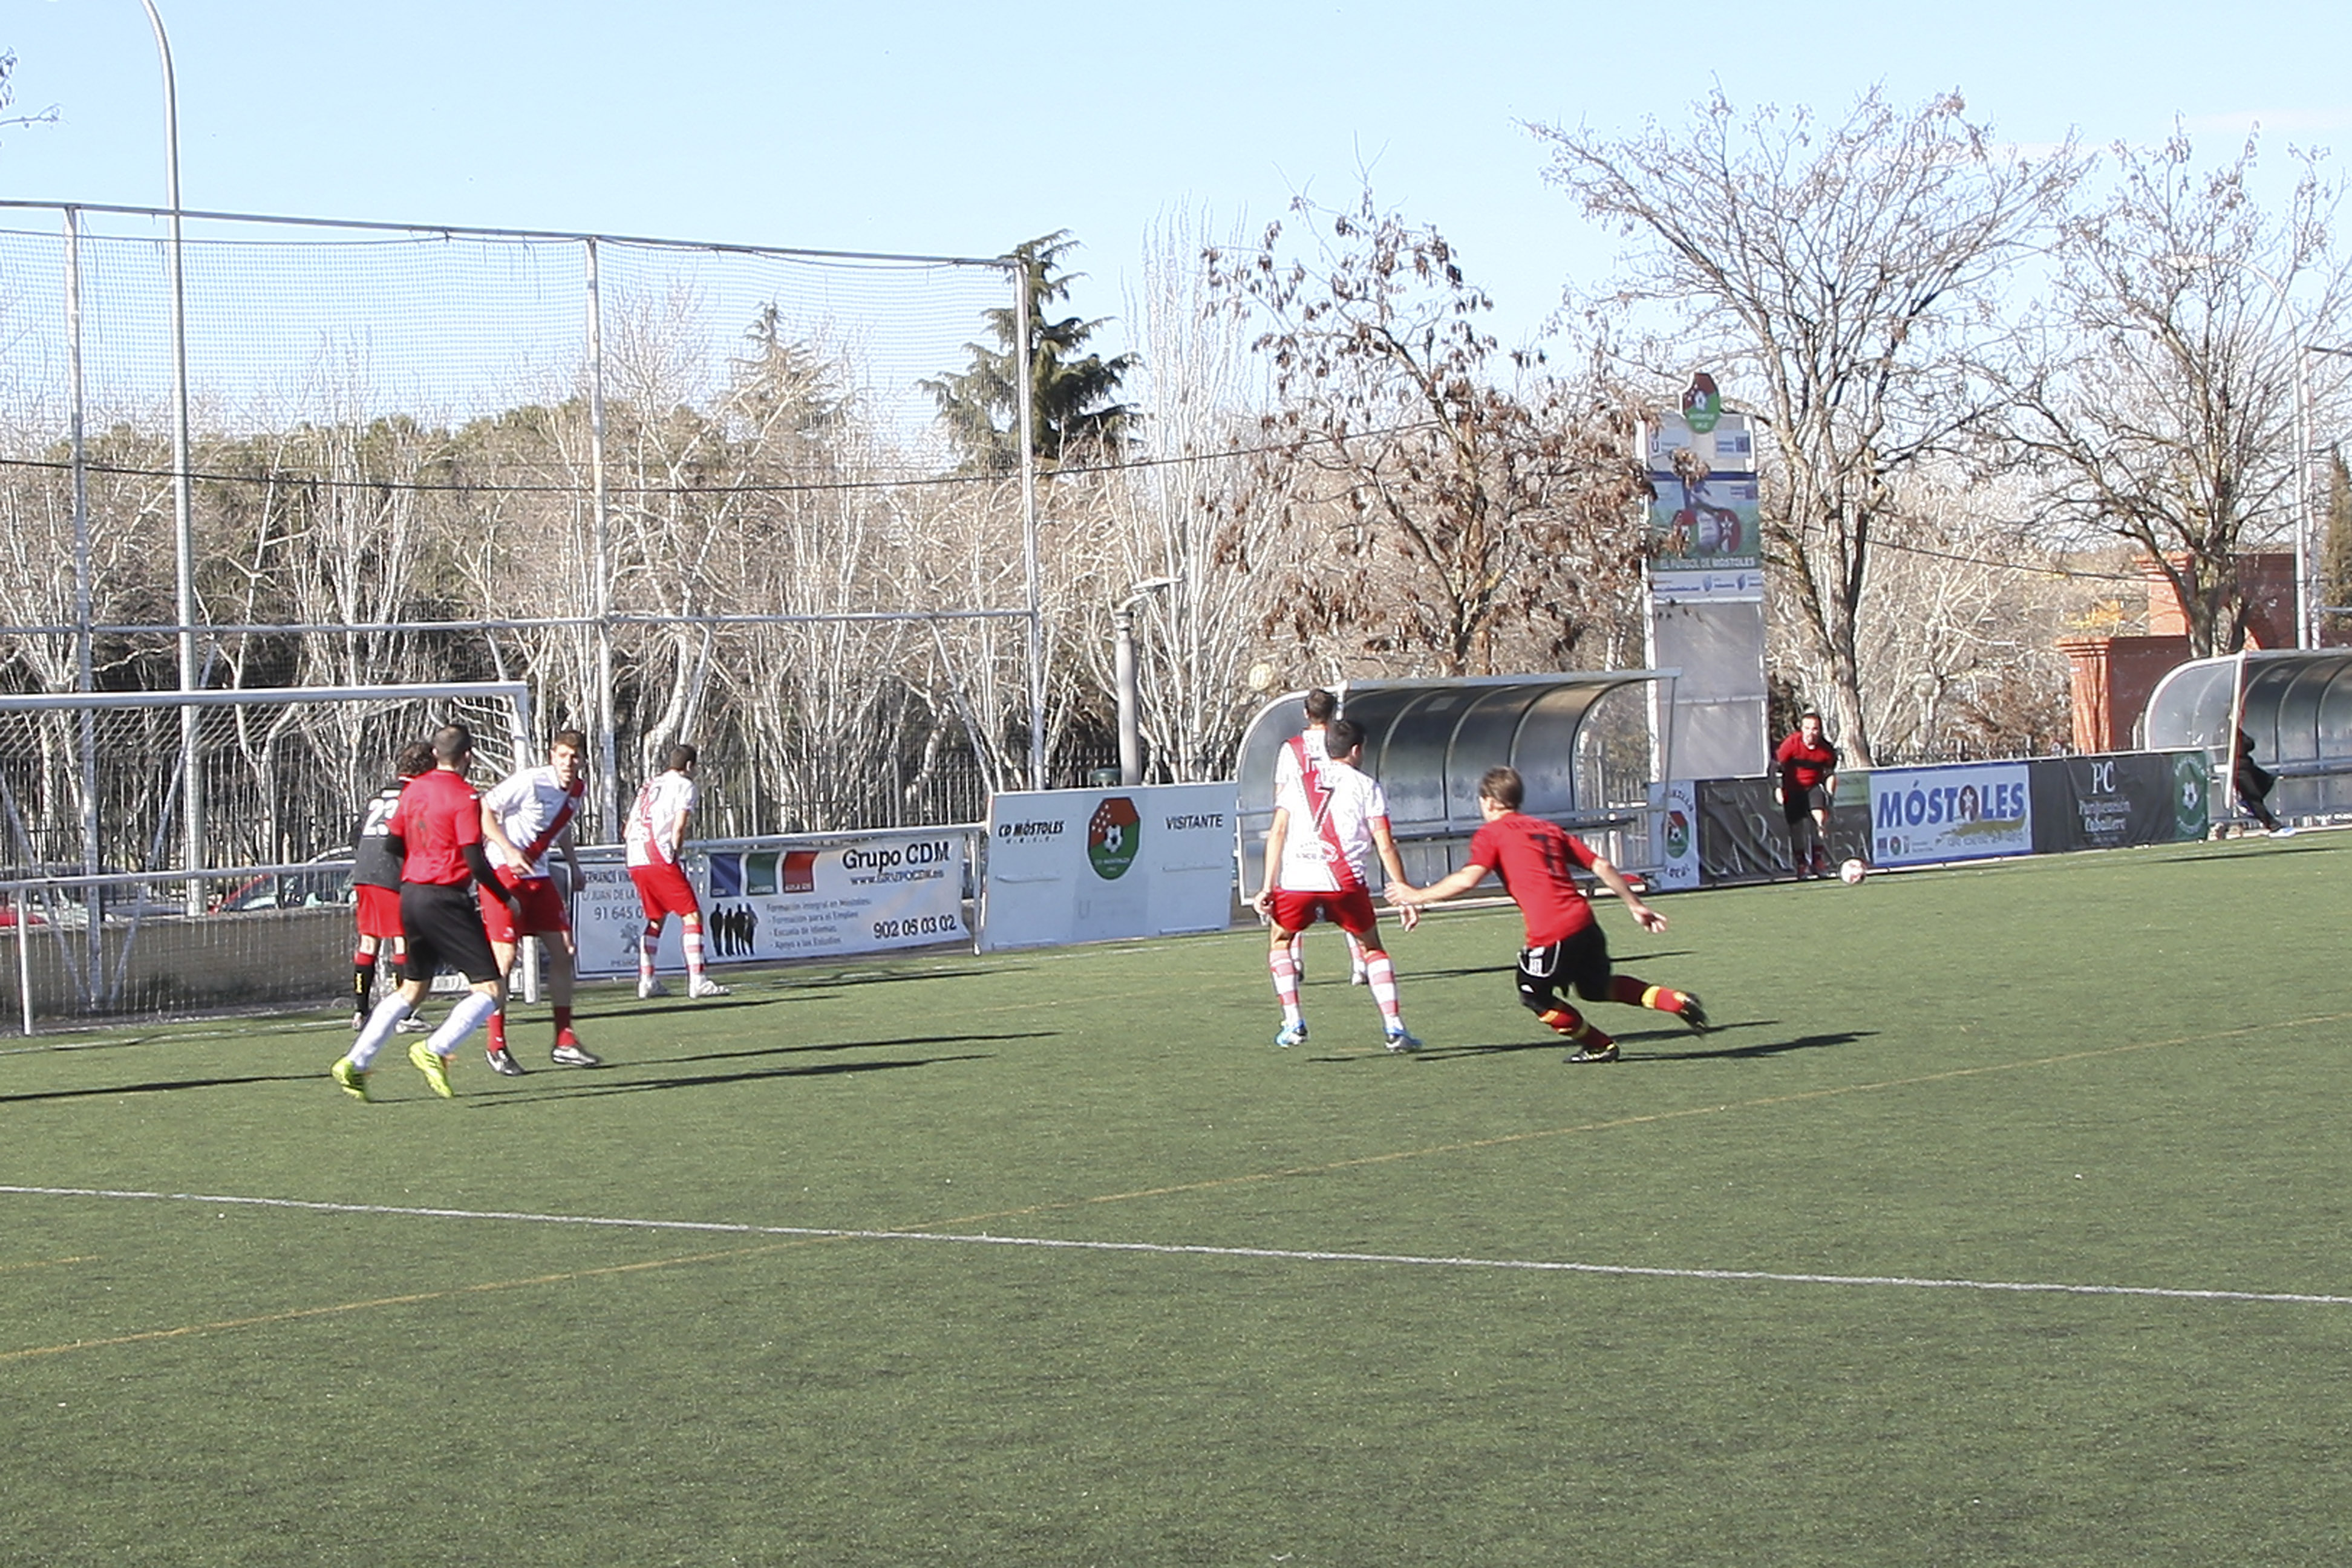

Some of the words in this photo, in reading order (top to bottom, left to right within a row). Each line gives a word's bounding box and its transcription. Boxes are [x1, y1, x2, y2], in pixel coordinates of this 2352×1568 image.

[2091, 760, 2116, 794] PC
[1165, 814, 1224, 829] VISITANTE
[1317, 786, 1335, 832] 7
[999, 824, 1012, 837] CD
[842, 849, 901, 873] Grupo
[906, 841, 950, 865] CDM
[594, 907, 607, 920] 91
[612, 906, 633, 920] 645
[874, 921, 900, 939] 902
[902, 919, 918, 936] 05
[921, 917, 937, 934] 03
[939, 914, 957, 932] 02
